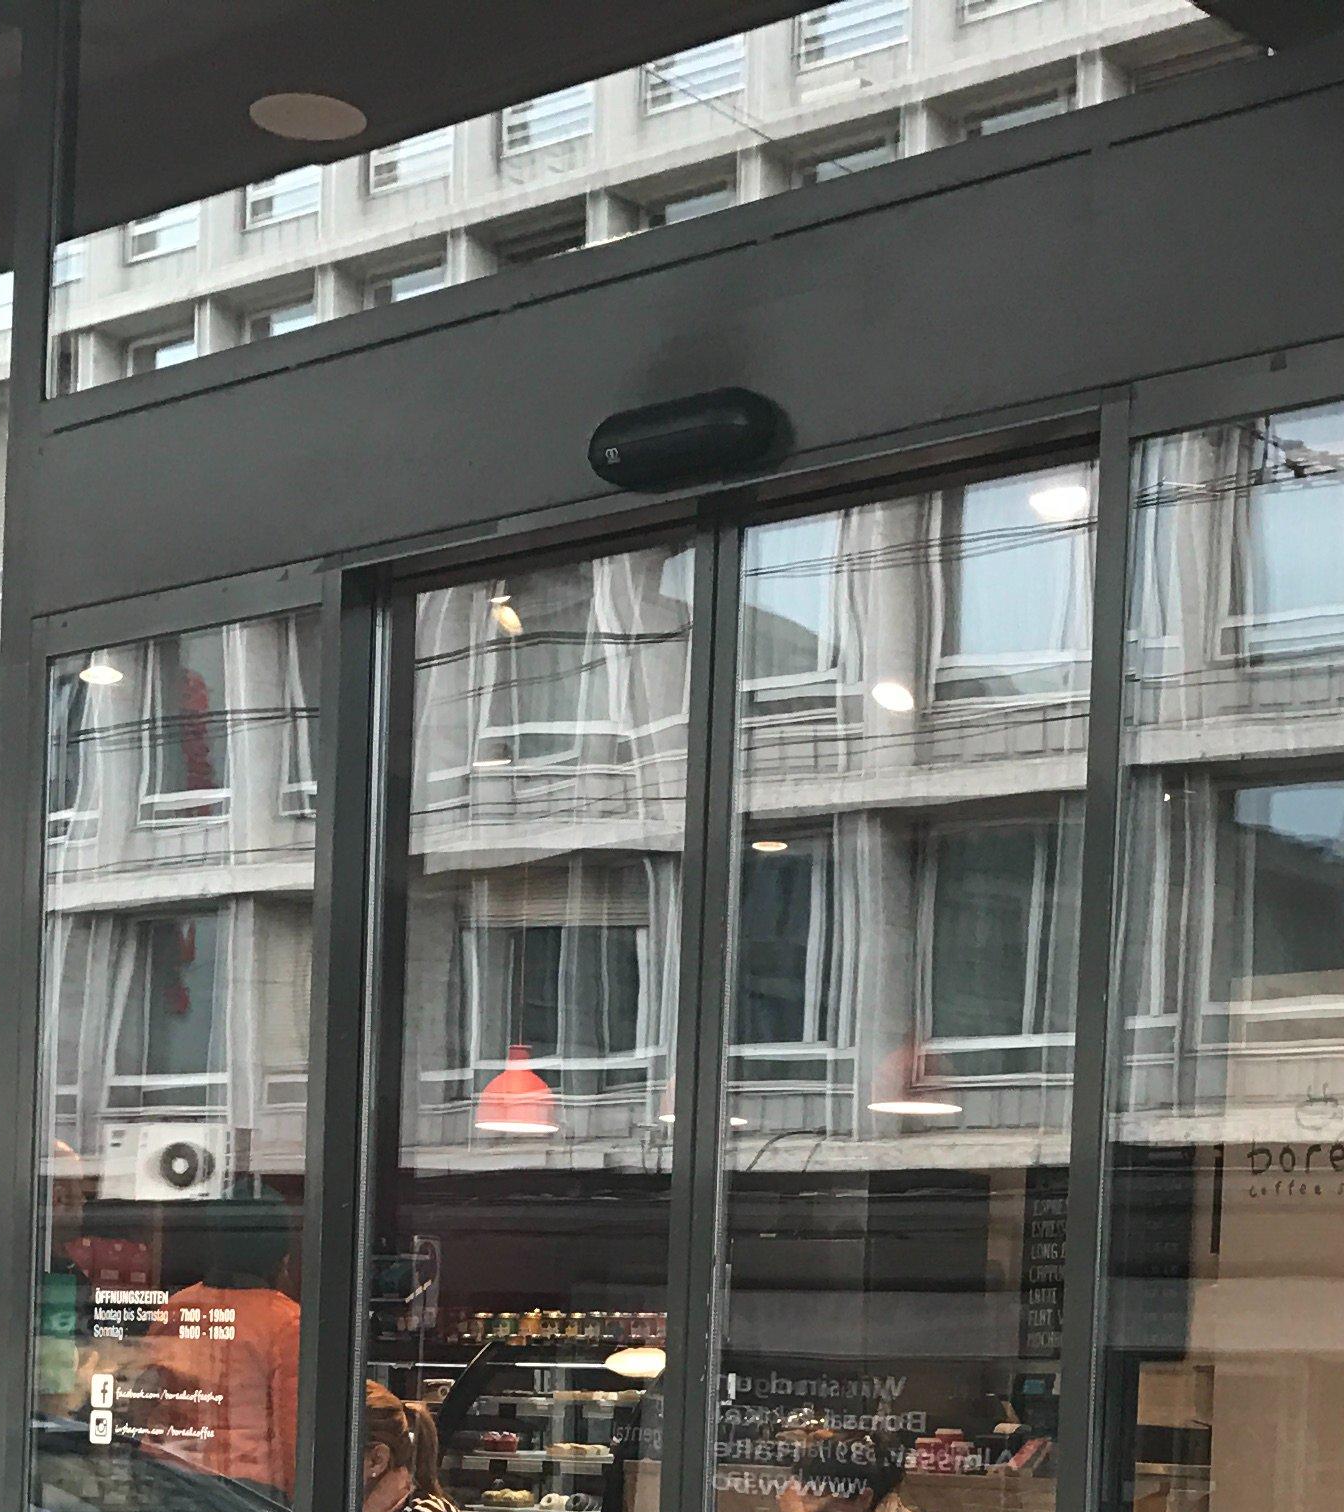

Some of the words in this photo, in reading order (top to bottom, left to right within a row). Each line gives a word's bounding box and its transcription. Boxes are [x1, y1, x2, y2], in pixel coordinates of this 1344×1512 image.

[95, 1287, 169, 1304] ÖFFNUNGSZEITEN
[94, 1307, 122, 1324] Montag
[123, 1307, 135, 1321] bis
[136, 1307, 169, 1324] Samstag
[93, 1324, 124, 1341] Sonntag
